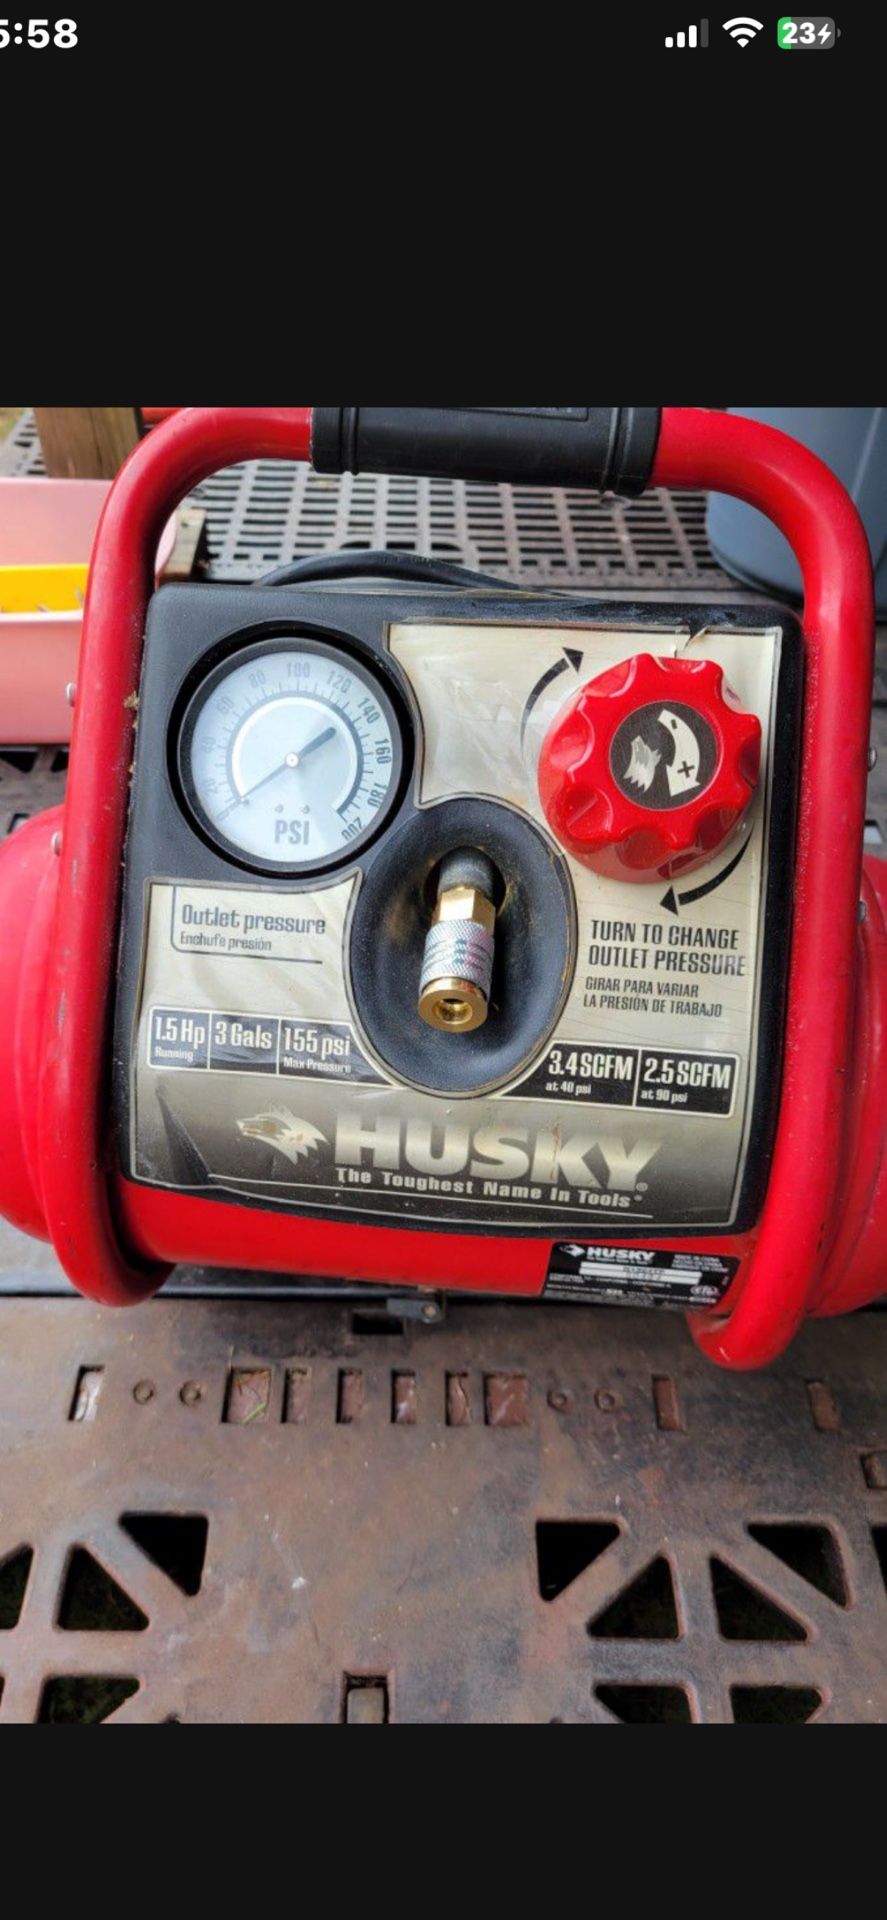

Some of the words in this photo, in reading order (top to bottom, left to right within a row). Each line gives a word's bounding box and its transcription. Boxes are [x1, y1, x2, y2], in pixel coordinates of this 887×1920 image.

[248, 670, 267, 689] 80
[286, 662, 311, 679] 100
[326, 670, 353, 694] 120
[217, 696, 235, 714] 60
[357, 697, 381, 725] 140
[374, 738, 392, 765] 160
[367, 782, 388, 809] 180
[274, 819, 310, 845] PSI
[181, 904, 240, 928] Outlet
[243, 914, 326, 935] pressure
[180, 931, 226, 948] Enchufe
[227, 934, 272, 951] presión
[592, 919, 636, 942] TURN
[642, 923, 663, 945] TO
[668, 925, 740, 950] CHANGE
[588, 945, 649, 969] OUTLET
[654, 950, 746, 977] PRESSURE
[585, 976, 621, 992] GIRAR
[623, 978, 653, 995] PARA
[656, 982, 699, 998] VARIAR
[583, 994, 596, 1008] LA
[652, 999, 665, 1014] DE
[670, 1001, 723, 1018] TRABAJO
[155, 1016, 178, 1042] 1.5
[181, 1018, 205, 1049] Hp
[214, 1021, 228, 1045] 3
[230, 1023, 273, 1049] Gals
[283, 1028, 318, 1052] 155
[321, 1035, 350, 1060] psi
[155, 1046, 194, 1062] Running
[283, 1056, 304, 1068] Max
[307, 1059, 352, 1073] Pressure
[549, 1050, 578, 1076] 3.4
[580, 1052, 634, 1081] SCFM
[643, 1057, 674, 1084] 2.5
[676, 1060, 732, 1089] SCFM
[545, 1082, 558, 1092] at
[560, 1081, 574, 1093] 40
[575, 1083, 592, 1096] psi
[641, 1089, 654, 1100] at
[656, 1089, 670, 1102] 90
[671, 1092, 688, 1104] psi
[335, 1167, 372, 1184] The
[381, 1171, 474, 1194] Toughest
[483, 1181, 542, 1200] Name
[550, 1187, 570, 1203] In
[578, 1190, 631, 1208] Tools
[587, 1246, 656, 1260] HUSKY
